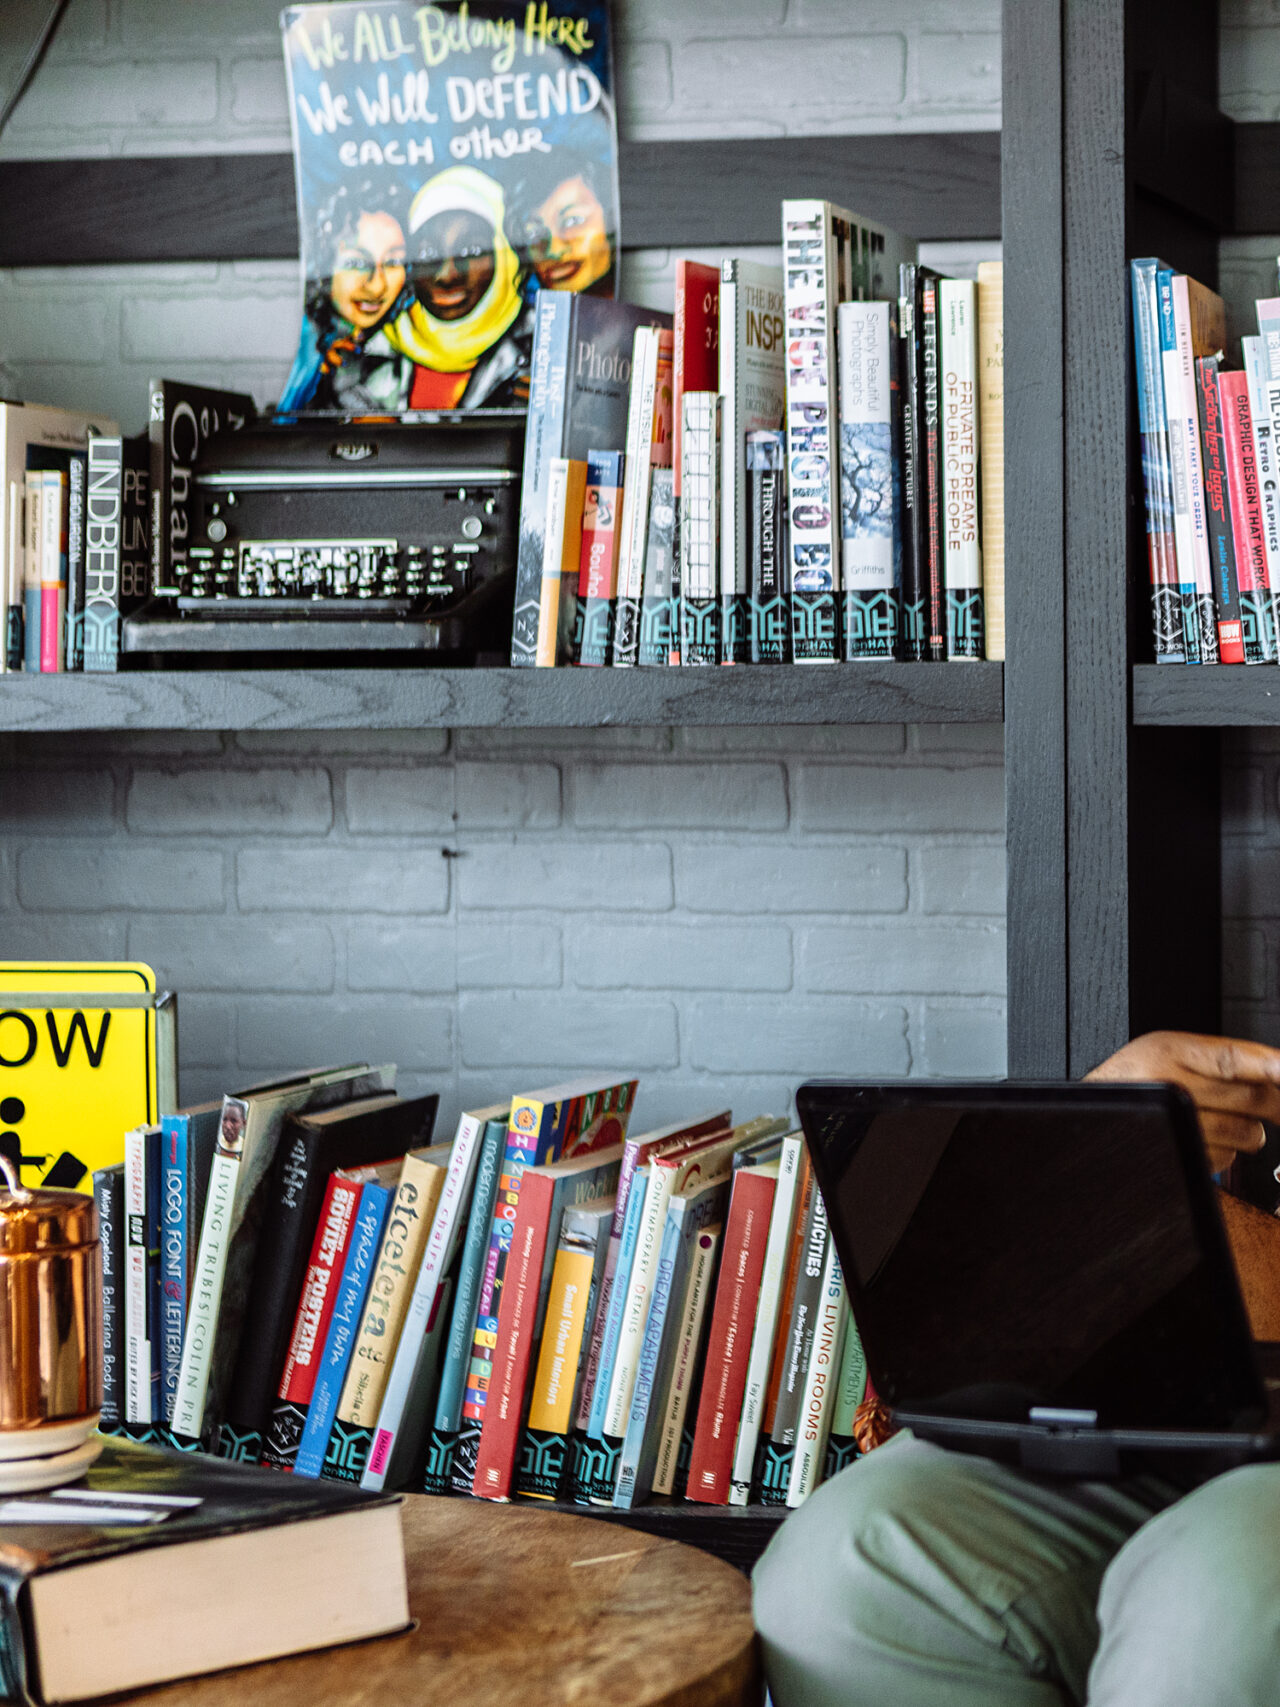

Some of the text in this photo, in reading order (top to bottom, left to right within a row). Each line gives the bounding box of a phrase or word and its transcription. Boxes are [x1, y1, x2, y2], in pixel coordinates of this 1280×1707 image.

[302, 18, 348, 71] We
[354, 11, 416, 63] ALL
[416, 1, 515, 74] Belong
[299, 81, 352, 135] We
[356, 69, 439, 126] Will
[745, 286, 765, 308] THE
[745, 310, 784, 352] INSP
[576, 341, 632, 385] Photo
[787, 213, 832, 530] THE VICE PHOTO
[851, 320, 865, 407] Photographs
[866, 312, 880, 412] Simply Beautiful
[924, 320, 938, 426] LEGENDS
[904, 403, 914, 510] GREATEST PICTURES
[946, 372, 961, 551] OF PUBLIC PEOPLE
[960, 381, 975, 542] PRIVATE DREAMS
[1237, 395, 1262, 542] GRAPHIC DESIGN THAT
[1257, 426, 1271, 473] RETRO
[761, 475, 777, 587] THROUGH THE
[1262, 480, 1279, 552] GRAPHICS
[850, 564, 886, 577] Griffiths
[0, 1011, 112, 1069] OW
[100, 1187, 112, 1220] Misty
[165, 1168, 183, 1225] LOGO,
[211, 1162, 231, 1232] LIVING
[426, 1126, 471, 1271] modern chairs
[618, 1143, 639, 1215] Popular Science
[100, 1219, 114, 1276] Copeland
[165, 1229, 183, 1280] FONT
[318, 1187, 348, 1267] SOVIET
[628, 1170, 667, 1335] CONTEMPORARY DETAILS
[330, 1215, 378, 1366] space own
[358, 1182, 420, 1365] etcetera etc.
[482, 1250, 499, 1314] ETHICAL
[102, 1285, 116, 1350] Ballerina
[165, 1301, 183, 1390] LETTERING
[295, 1265, 331, 1366] POSTERS
[499, 1226, 536, 1420] Working Travail Arbeit
[546, 1283, 578, 1406] Small Urban Interiors
[632, 1258, 673, 1423] DREAM APARTMENTS
[712, 1249, 750, 1439] Spaces Räume
[103, 1355, 117, 1392] Body
[746, 1398, 757, 1425] Sweet
[799, 1304, 838, 1495] LIVING ROOMS ASSOULINE
[372, 1434, 390, 1471] TASCHEN
[658, 1438, 674, 1487] PRODUCTIONS
